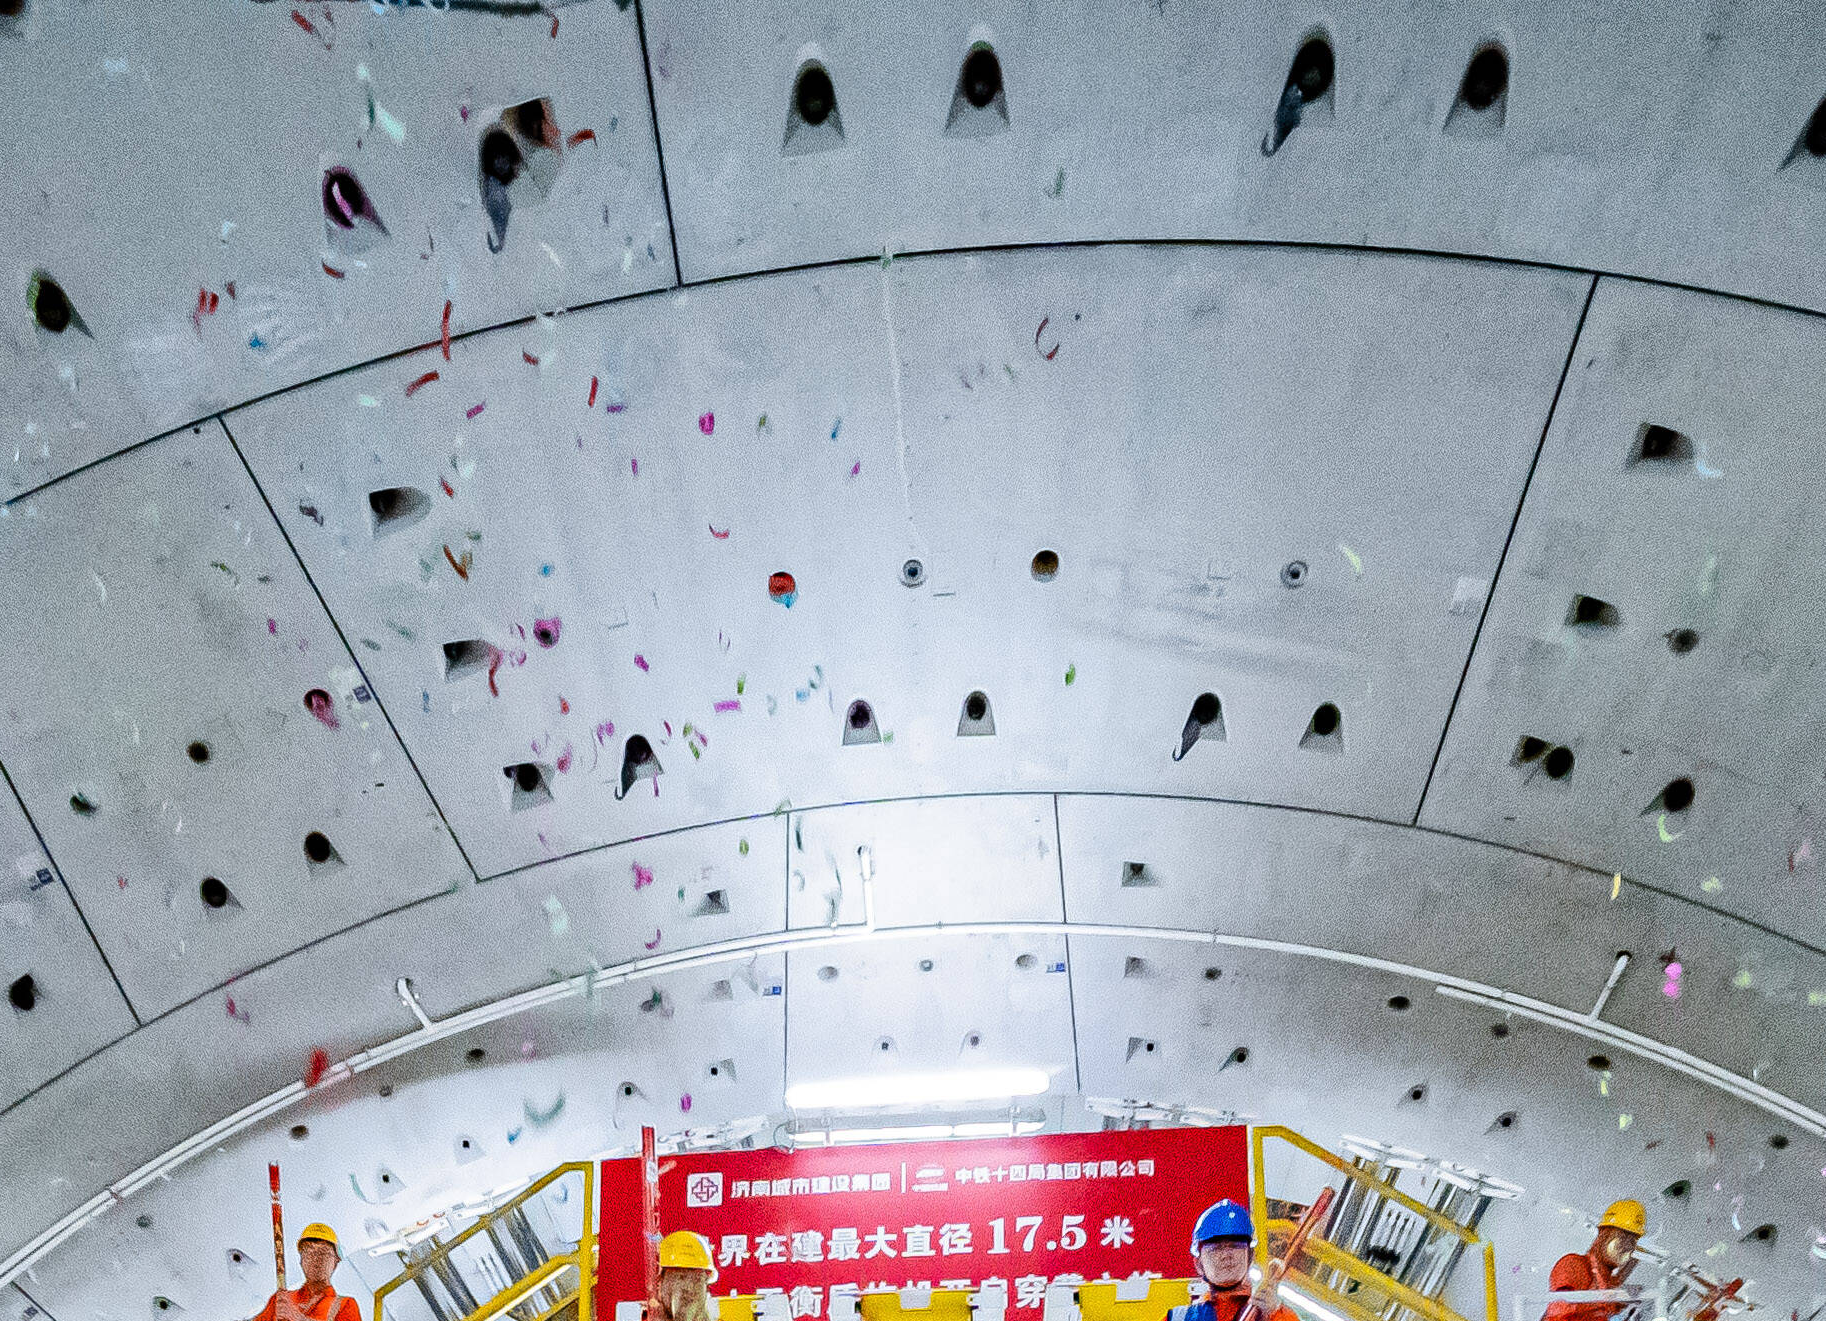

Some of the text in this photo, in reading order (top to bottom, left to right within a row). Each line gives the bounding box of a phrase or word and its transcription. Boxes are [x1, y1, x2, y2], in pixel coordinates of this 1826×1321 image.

[955, 1159, 1154, 1186] 中铁十四局集团有限公司
[987, 1216, 1087, 1254] 17.5
[1101, 1216, 1134, 1248] 米
